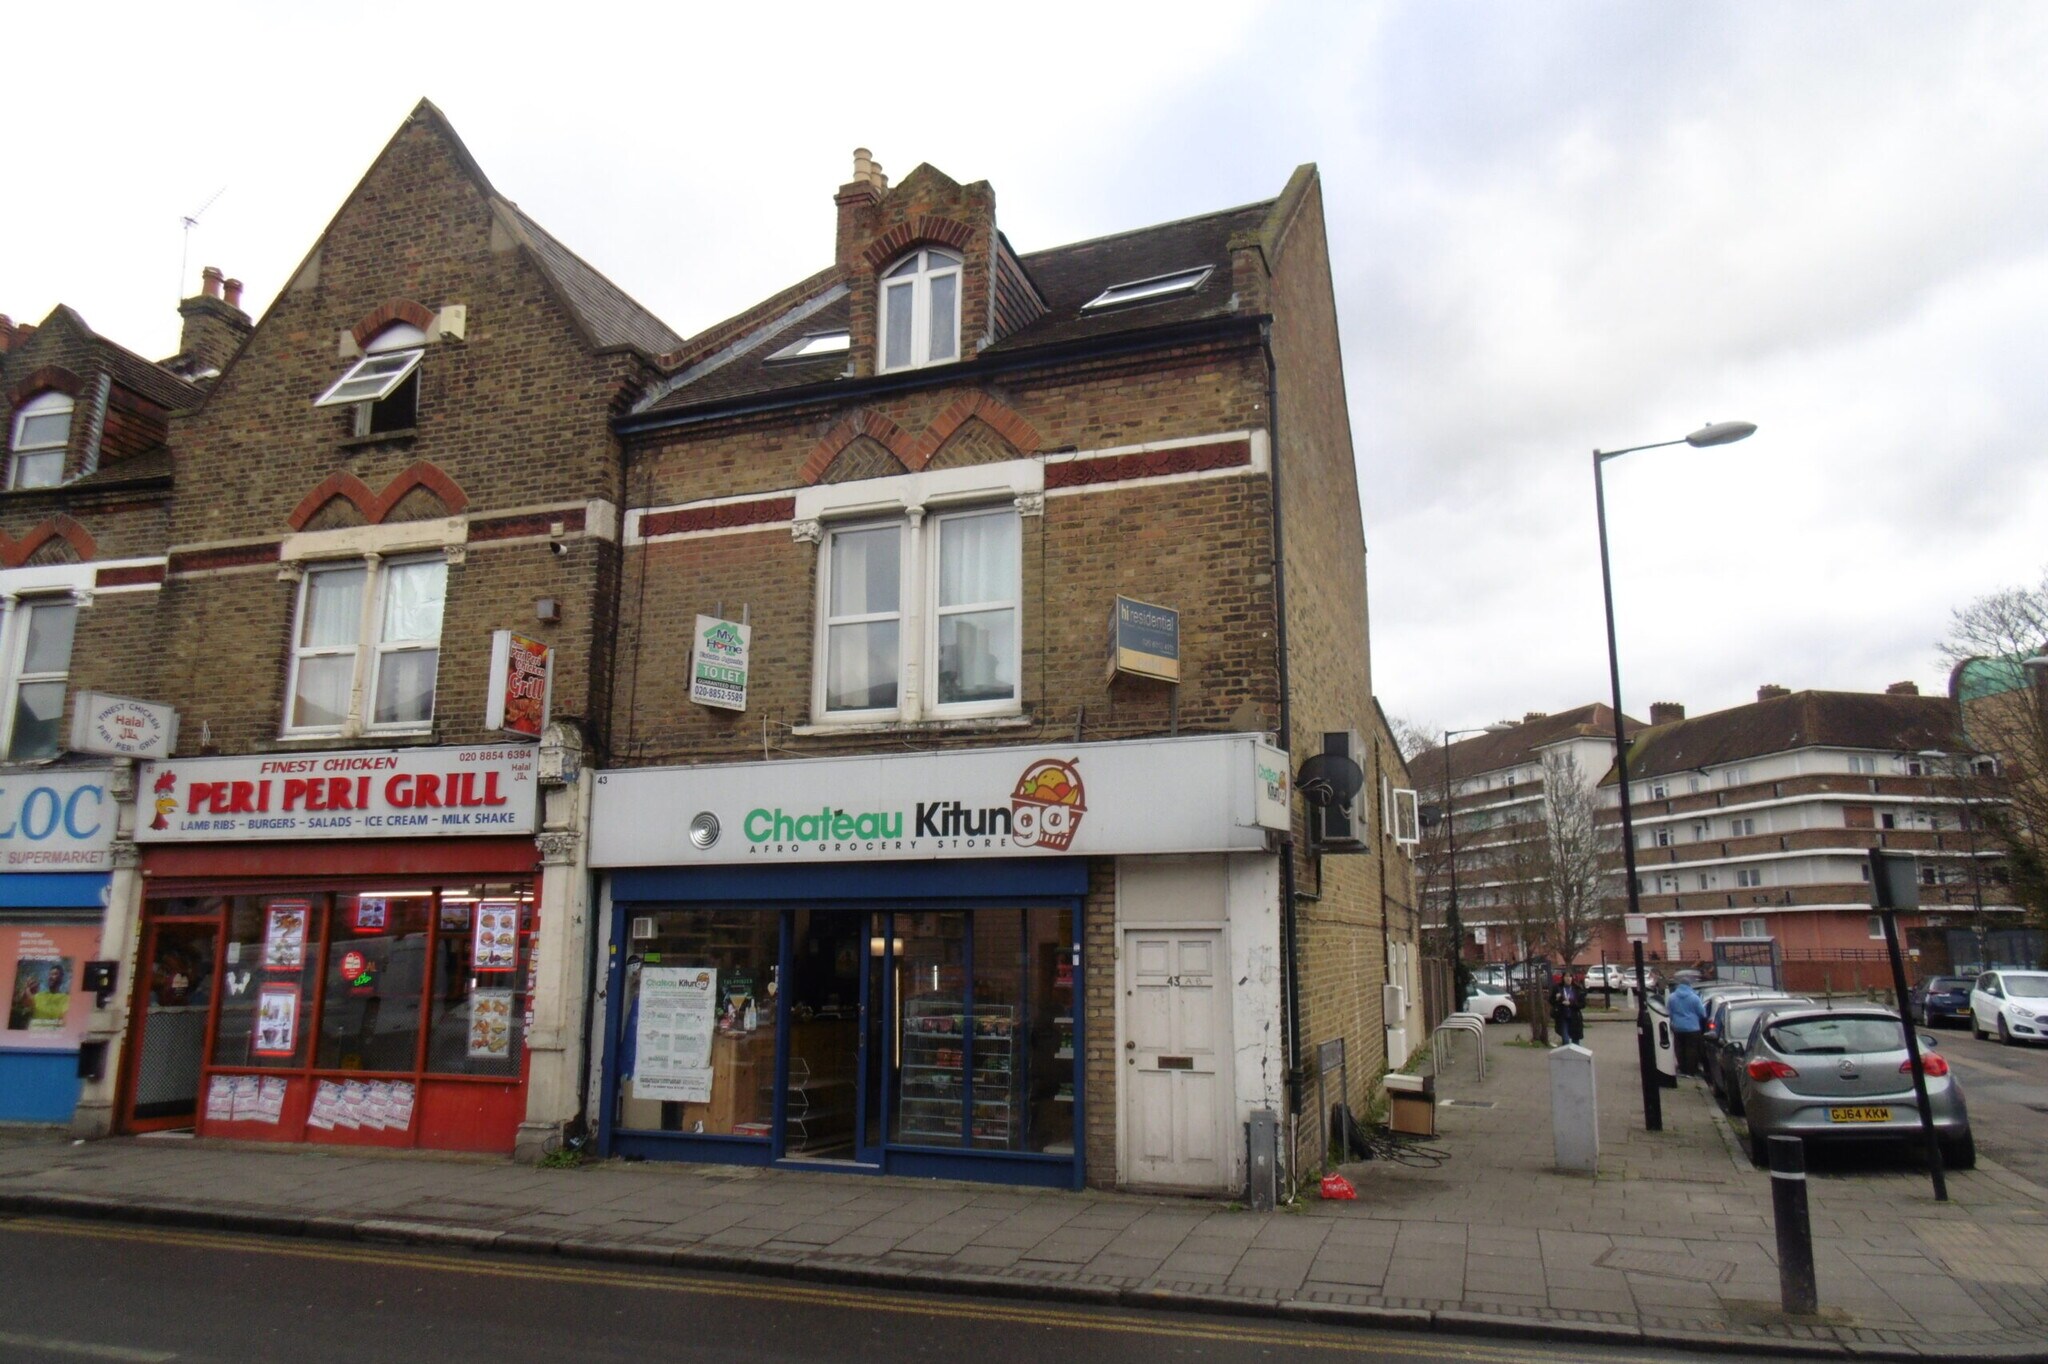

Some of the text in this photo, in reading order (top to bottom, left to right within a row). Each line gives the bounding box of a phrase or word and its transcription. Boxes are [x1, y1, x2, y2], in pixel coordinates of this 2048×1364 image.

[1130, 610, 1174, 632] residential
[716, 629, 734, 642] My
[703, 665, 740, 682] TO LET
[509, 672, 545, 700] Grill
[694, 685, 743, 702] 020-8852-5589
[98, 703, 161, 730] FINEST CHICKEN
[116, 715, 145, 728] Halal
[459, 750, 532, 762] 020 8854 6394
[260, 756, 398, 774] FINEST CHICKEN
[511, 763, 532, 771] Halal
[597, 775, 608, 785] 43
[187, 771, 508, 815] PERI PERI GRILL
[180, 820, 210, 831] LAMB
[213, 820, 236, 830] RIBS
[248, 818, 296, 829] BURGERS
[308, 817, 352, 828] SALADS
[365, 816, 383, 826] ICE
[387, 815, 428, 826] CREAM
[442, 813, 470, 825] MILK
[475, 812, 515, 824] SHAKE
[915, 801, 1071, 848] Kitunga
[749, 838, 1006, 854] AFRO GROCERY STORE
[8, 850, 106, 865] SUPERMARKET
[1166, 975, 1180, 987] 43
[1831, 1108, 1862, 1120] GJ64
